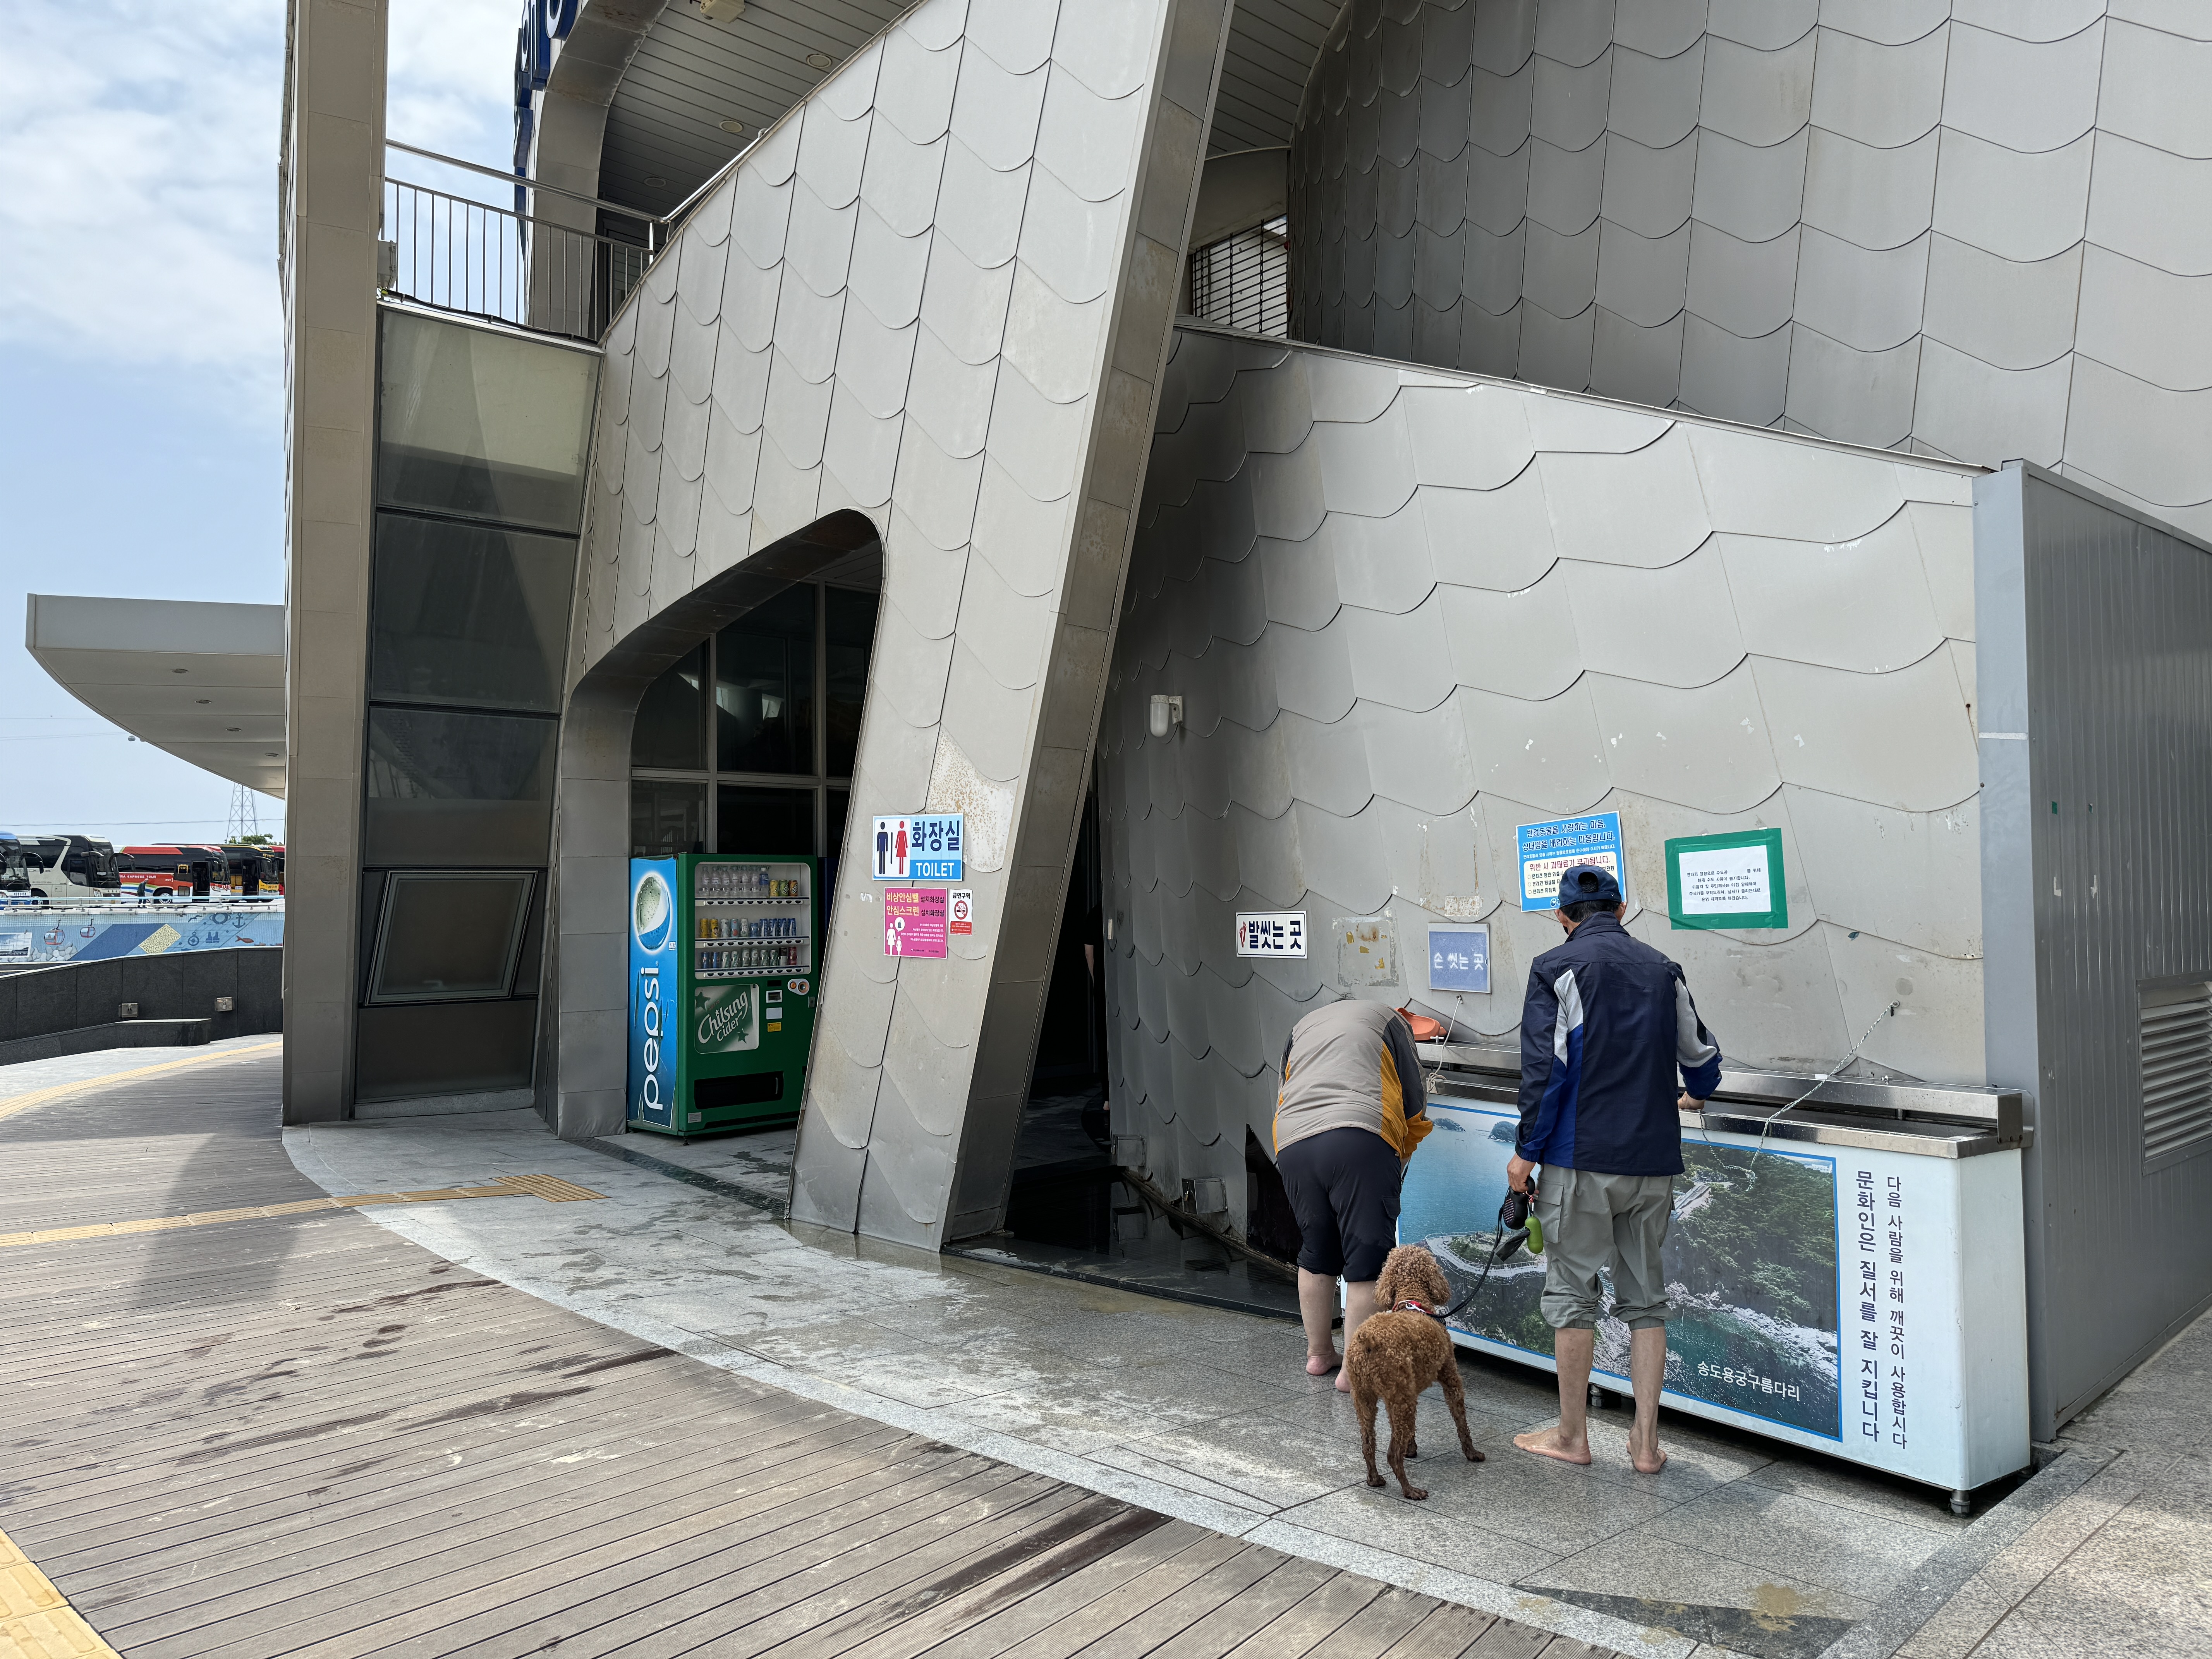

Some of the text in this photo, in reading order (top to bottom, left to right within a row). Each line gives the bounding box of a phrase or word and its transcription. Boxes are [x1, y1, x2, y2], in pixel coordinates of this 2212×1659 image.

[912, 820, 960, 851] 화장실
[1527, 826, 1558, 838] 반려동물을
[1562, 821, 1587, 832] 사랑하는
[1550, 836, 1576, 848] 배려하는
[1579, 832, 1615, 843] 마음입니다.
[916, 862, 954, 877] TOILET
[1530, 863, 1541, 871] 위반
[1551, 860, 1575, 869] 과태료가
[887, 892, 919, 903] 비상안심벨
[887, 905, 919, 916] 안심스크린
[1249, 921, 1301, 950] 발씻는 곳
[1434, 952, 1484, 970] 손 씻는 곳
[698, 991, 748, 1044] Chilsung
[641, 967, 663, 1110] pepsi
[1856, 1170, 1880, 1443] 문화인은 질서를 잘 지킵니다
[1887, 1176, 1907, 1450] 다음 사람을 위해 깨끗이 사용합시다
[1697, 1360, 1800, 1402] 송도용궁구름다리
